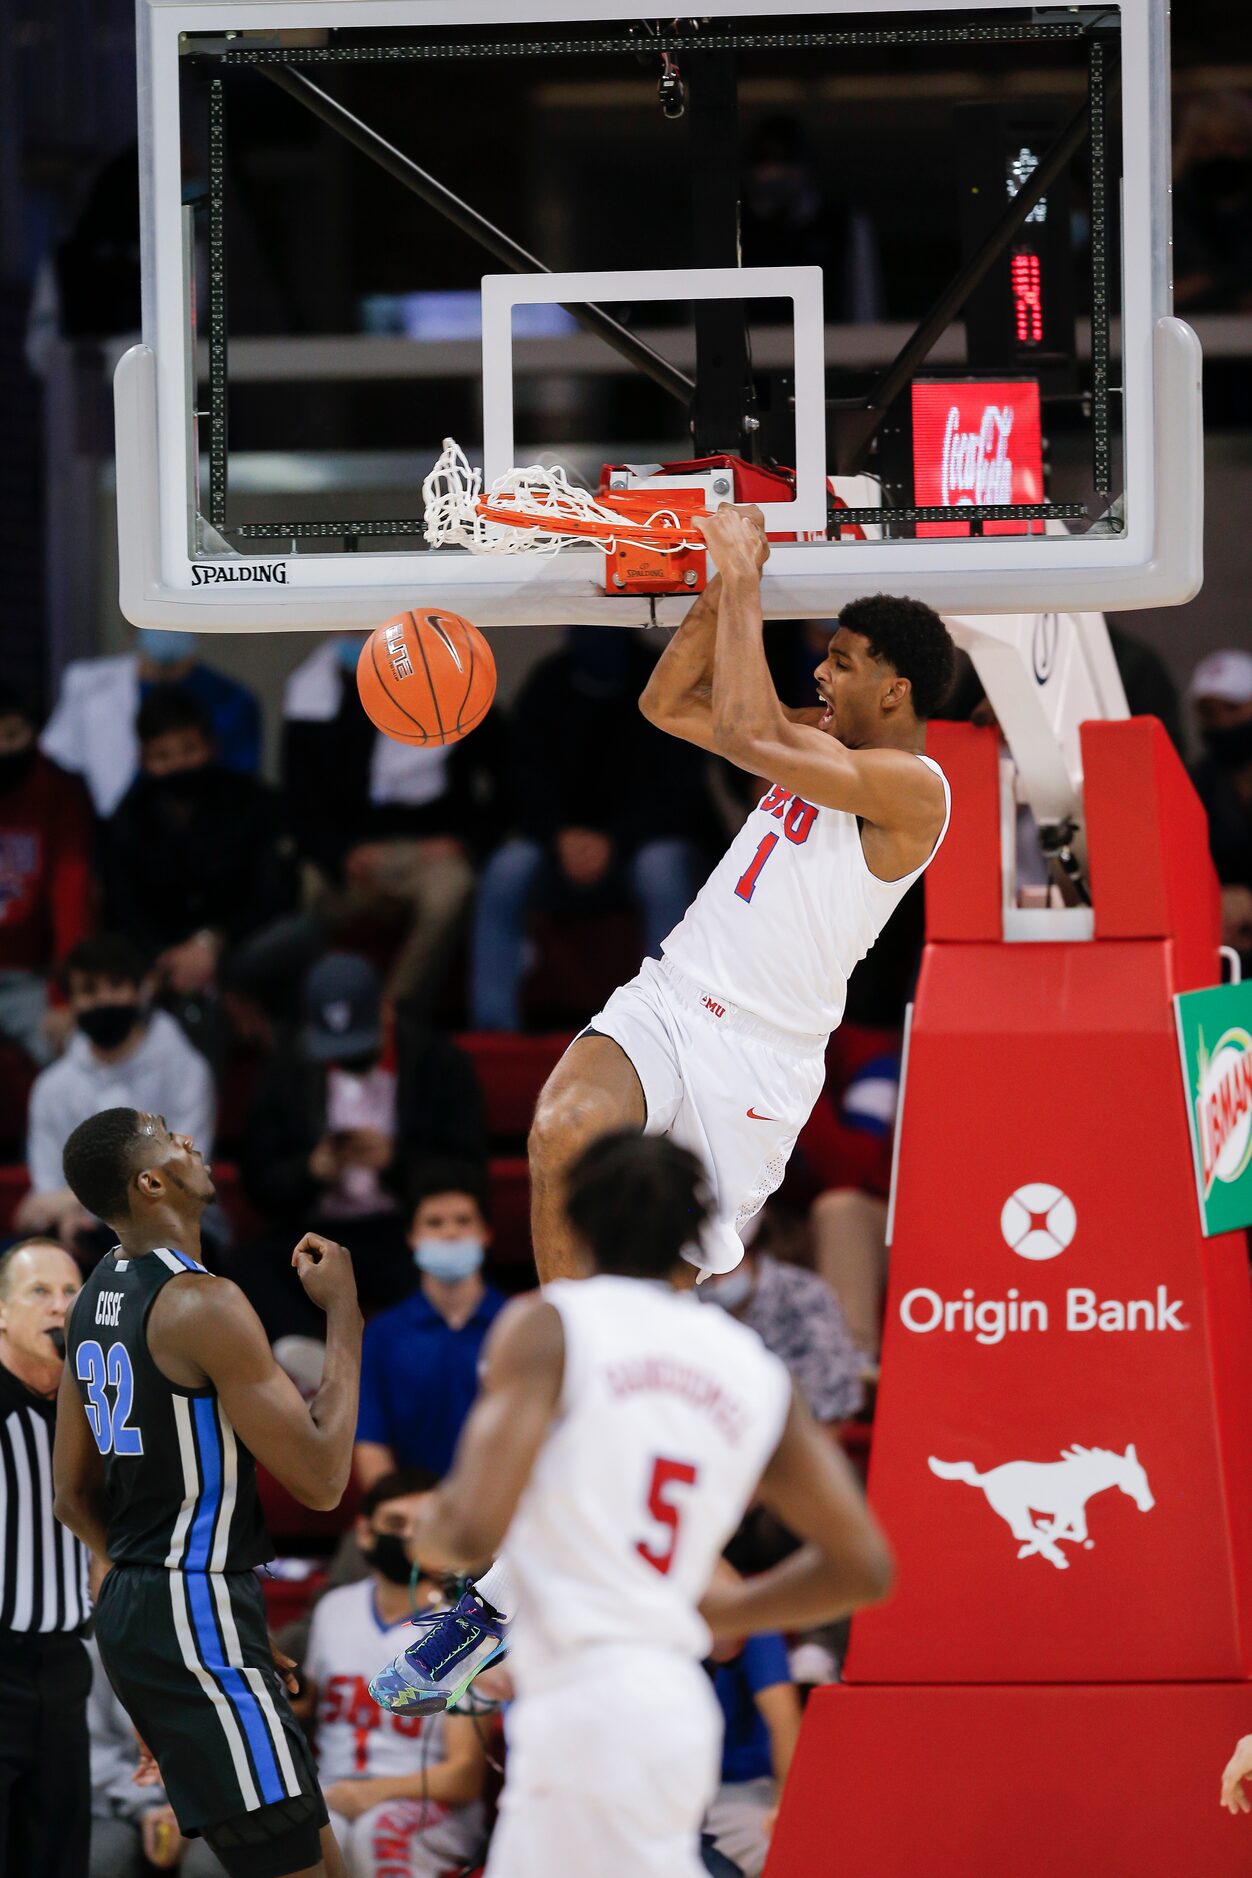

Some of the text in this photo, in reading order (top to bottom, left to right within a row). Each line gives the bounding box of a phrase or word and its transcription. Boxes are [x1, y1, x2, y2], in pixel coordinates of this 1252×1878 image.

[191, 562, 286, 586] SPALDING
[626, 569, 664, 578] SPALDING
[734, 831, 780, 903] 1
[95, 1291, 125, 1327] CISSE
[900, 1285, 1184, 1345] Origin Bank
[76, 1340, 145, 1456] 32
[635, 1457, 696, 1575] 5
